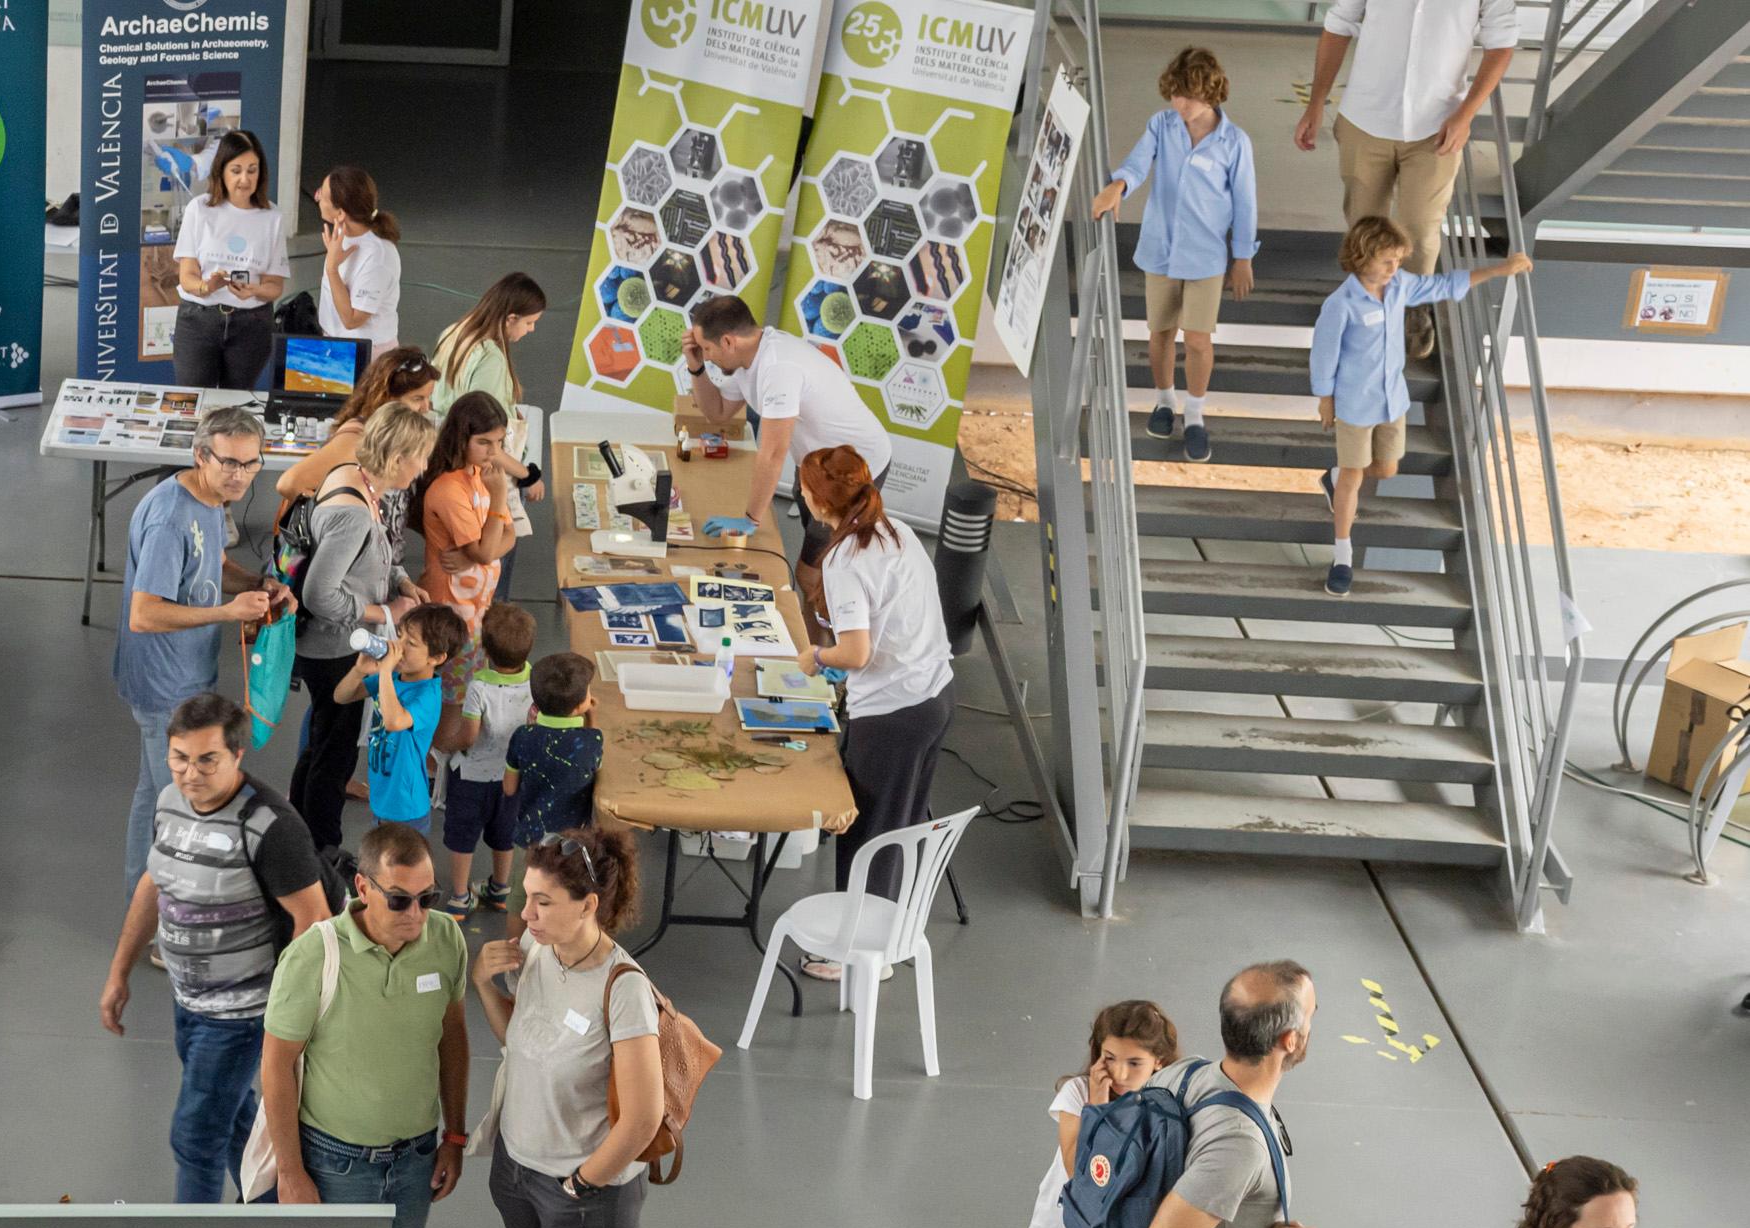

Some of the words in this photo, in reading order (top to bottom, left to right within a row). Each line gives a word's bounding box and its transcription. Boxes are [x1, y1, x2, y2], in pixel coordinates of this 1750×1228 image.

[100, 11, 270, 37] ArchaeChemis
[99, 43, 143, 54] Chemical
[145, 41, 189, 52] Solutions
[191, 40, 200, 49] in
[705, 37, 727, 51] DELS
[728, 43, 776, 63] MATERIALS
[707, 26, 747, 43] INSTITUT
[749, 37, 762, 46] DE
[763, 39, 801, 57] CIÈNCIA
[99, 54, 138, 66] Geology
[140, 53, 158, 63] and
[159, 52, 200, 62] Forensic
[202, 51, 240, 61] Science
[913, 55, 937, 68] DELS
[938, 60, 987, 77] MATERIALS
[915, 45, 957, 60] INSTITUT
[960, 53, 972, 63] DE
[94, 72, 122, 204] VALÈNCIA
